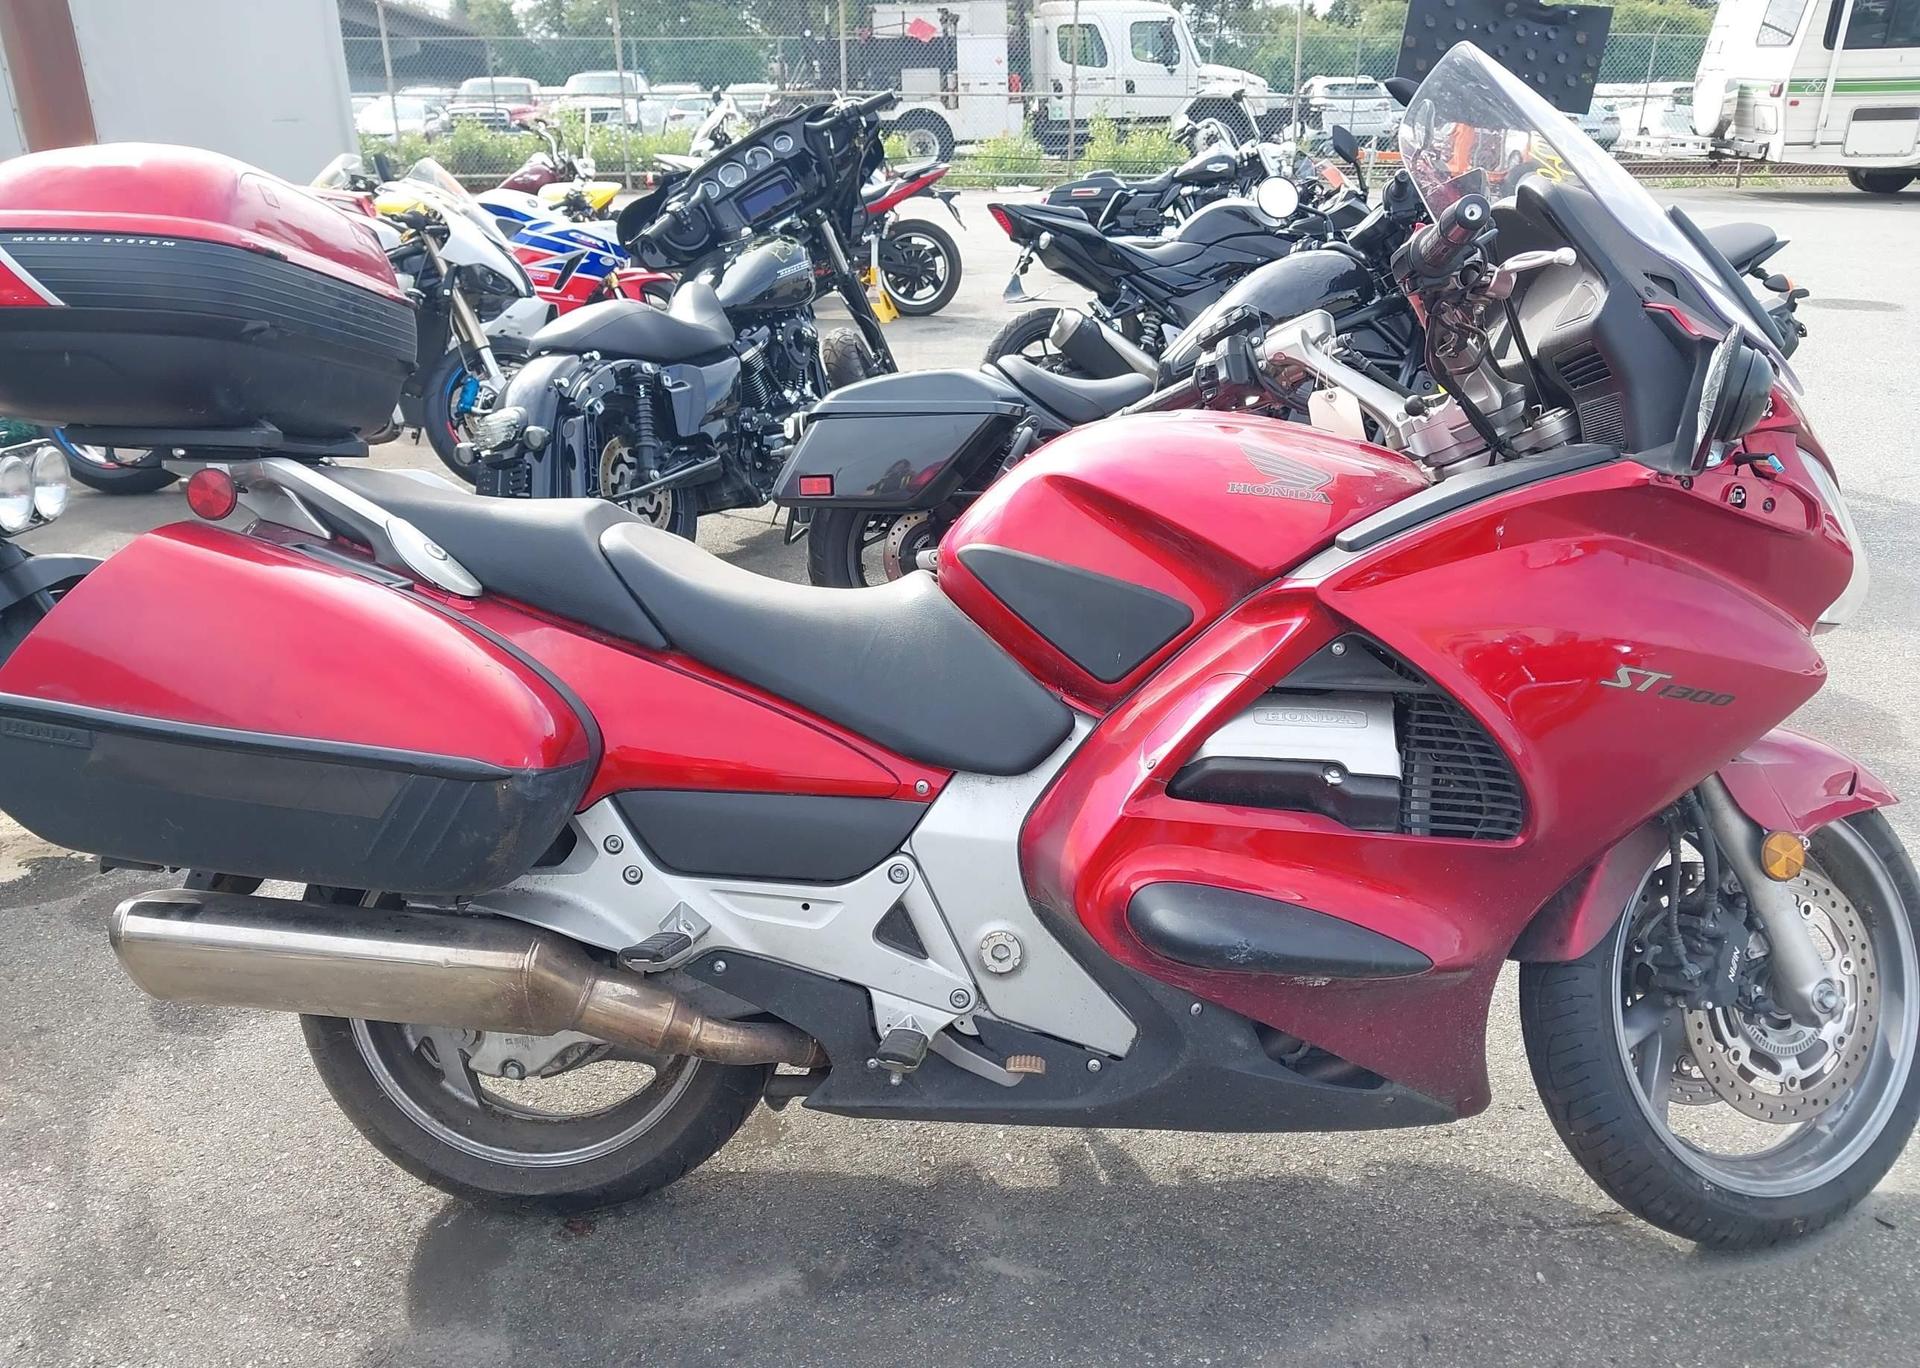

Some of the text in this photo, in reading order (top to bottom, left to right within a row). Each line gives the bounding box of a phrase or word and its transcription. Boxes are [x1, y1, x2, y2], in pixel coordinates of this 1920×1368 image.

[12, 235, 176, 247] MONOKEY SYSTEM
[1226, 481, 1335, 505] HONDA
[1599, 665, 1736, 706] ST 1300
[1264, 710, 1359, 725] HONDA
